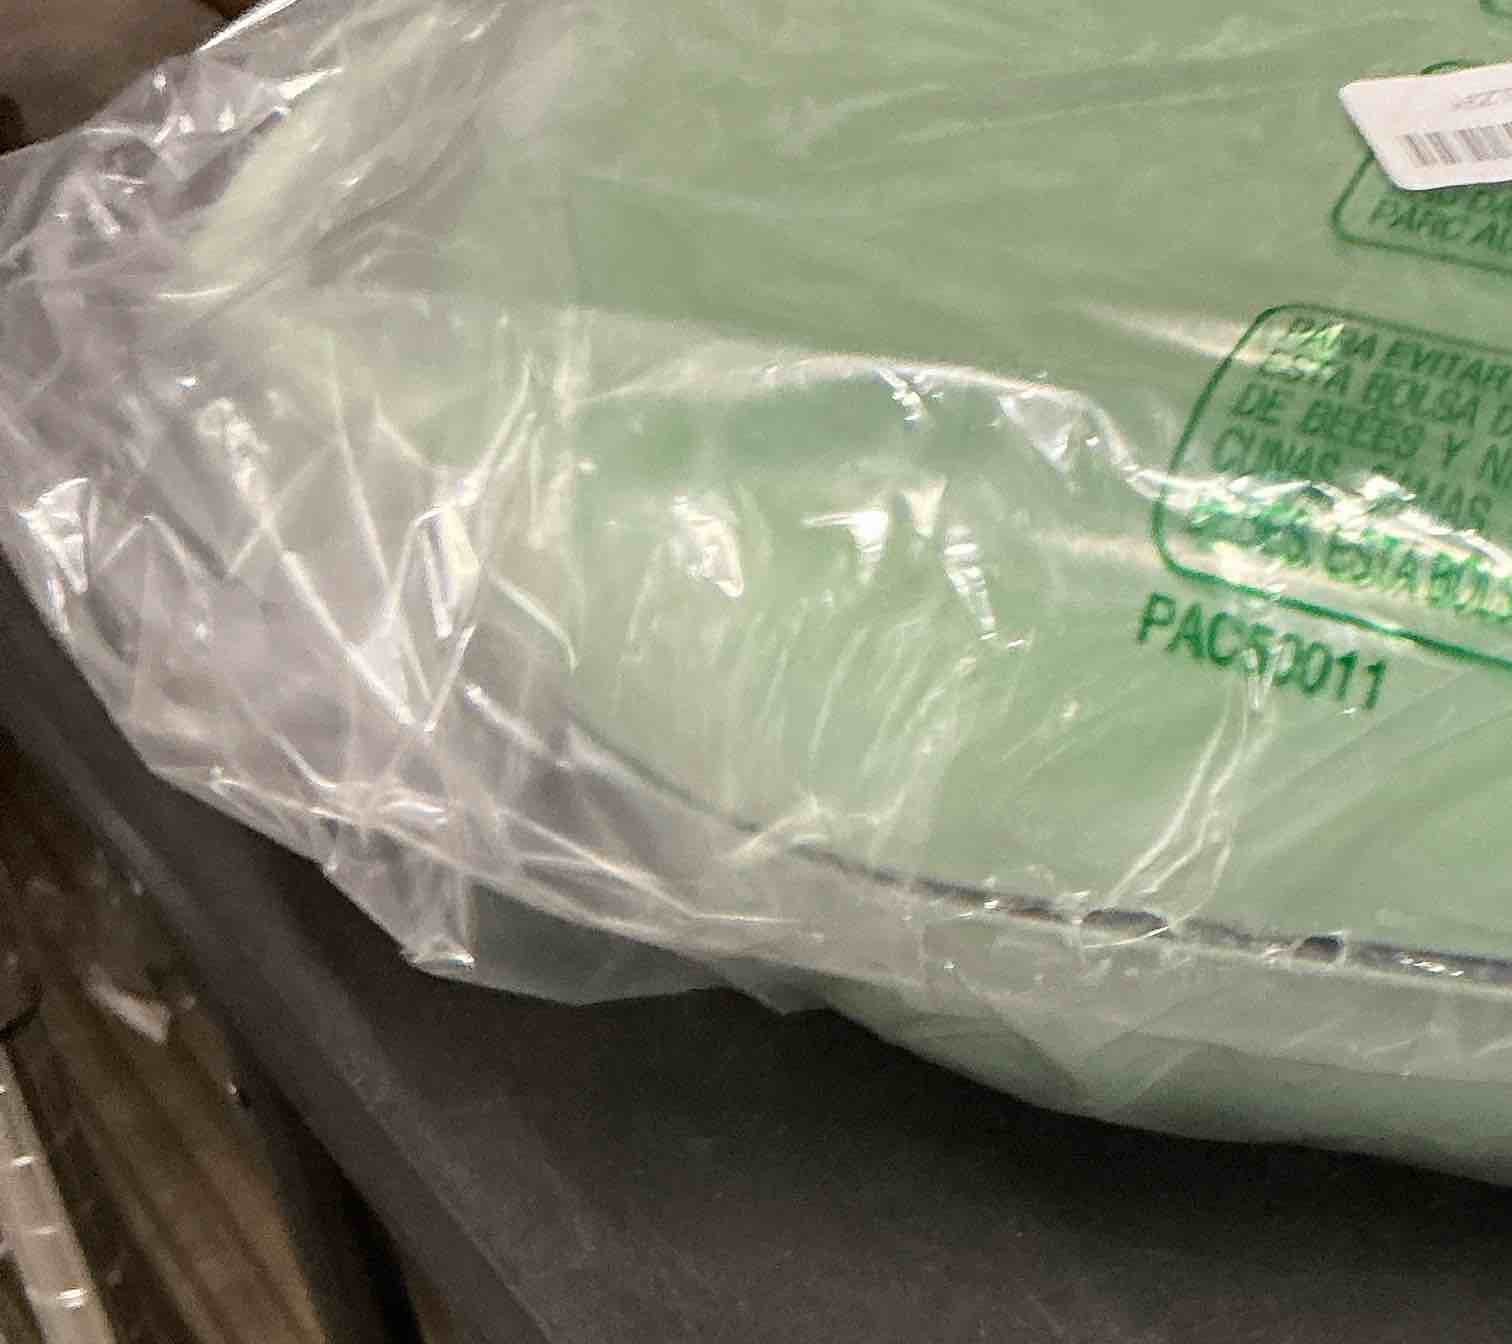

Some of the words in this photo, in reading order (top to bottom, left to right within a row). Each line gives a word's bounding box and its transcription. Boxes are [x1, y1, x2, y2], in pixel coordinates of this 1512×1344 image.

[1368, 197, 1464, 241] PARC
[1227, 381, 1286, 427] DE
[1440, 431, 1472, 471] Y
[1361, 370, 1481, 429] BOLSA
[1138, 590, 1389, 712] PAC50011
